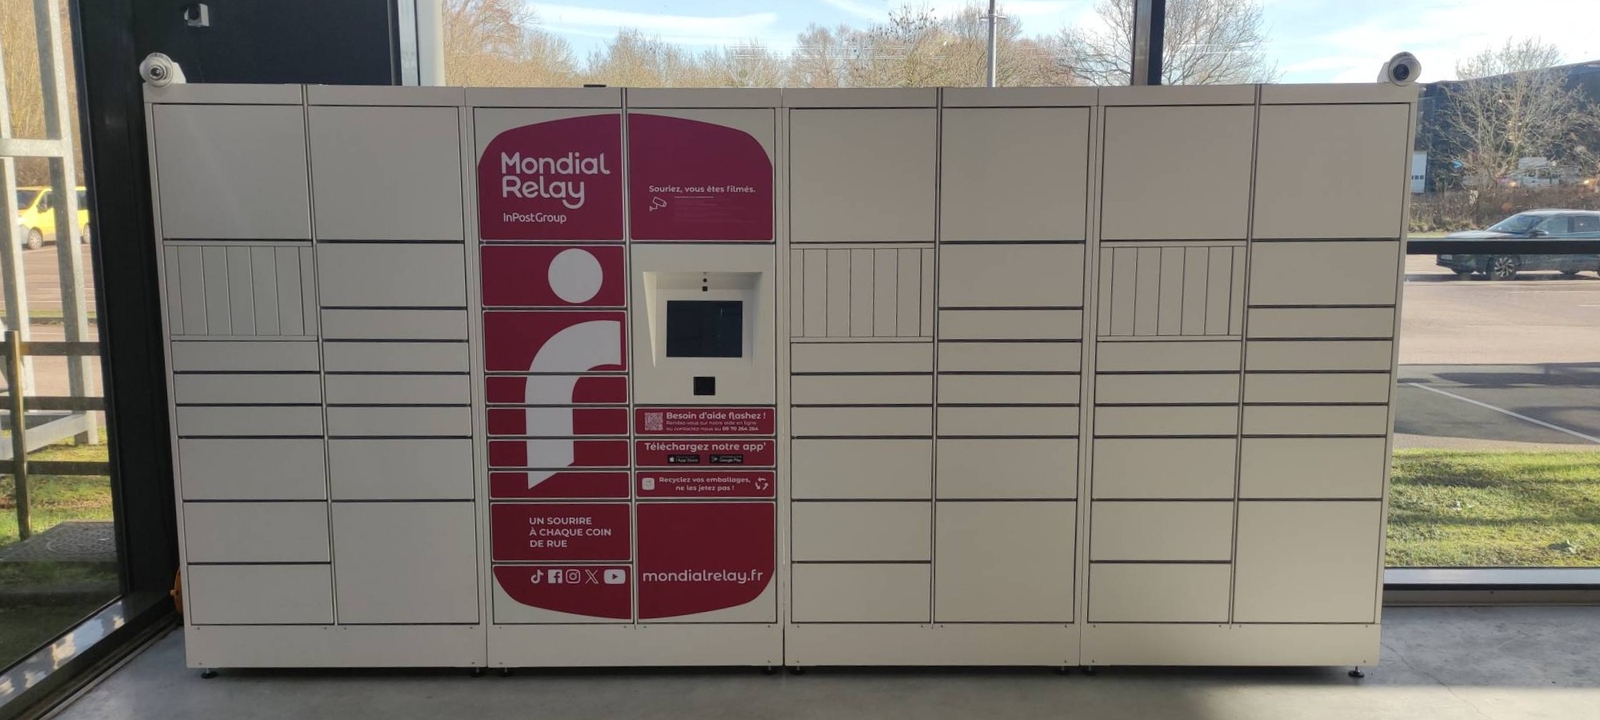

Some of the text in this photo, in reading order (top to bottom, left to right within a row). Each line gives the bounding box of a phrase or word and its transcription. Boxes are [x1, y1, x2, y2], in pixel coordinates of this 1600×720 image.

[501, 151, 611, 175] Mondial
[502, 175, 585, 210] Relay
[649, 185, 683, 193] Souriez,
[707, 185, 725, 193] êtes
[726, 185, 756, 193] filmés.
[666, 411, 766, 420] Besoin d'aide flashez !
[644, 442, 766, 452] Téléchargez notre app'
[706, 476, 751, 484] emballages,
[529, 517, 593, 525] UN SOURIRE
[529, 527, 612, 537] À CHAQUE COIN
[642, 569, 764, 584] mondialrelay.fr
